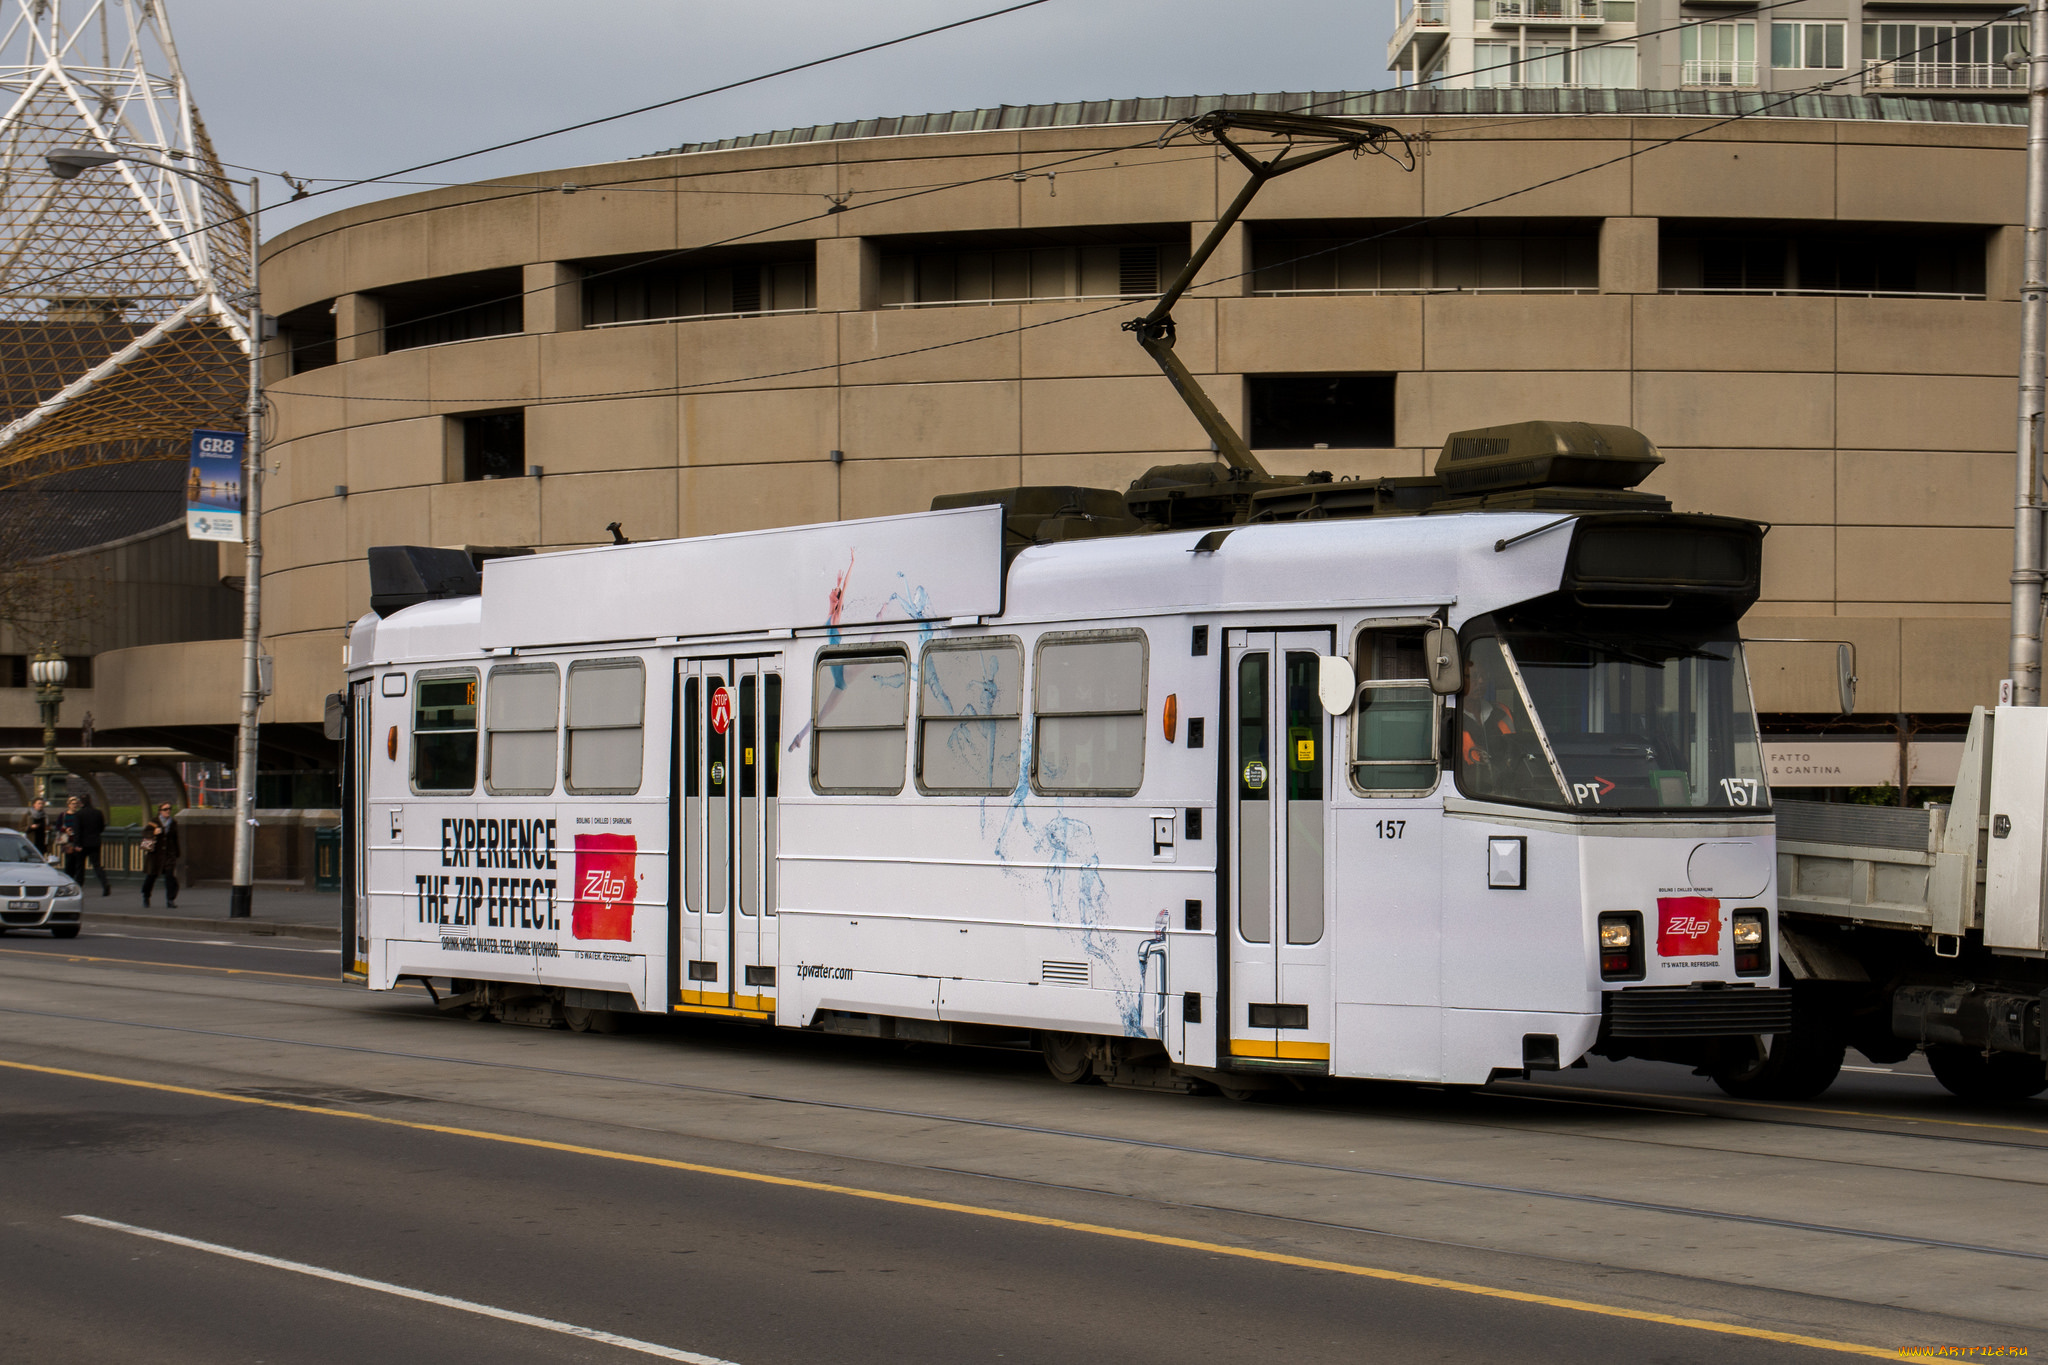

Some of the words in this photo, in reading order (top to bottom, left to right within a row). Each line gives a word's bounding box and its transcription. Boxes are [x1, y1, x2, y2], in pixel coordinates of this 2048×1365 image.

[200, 437, 235, 453] GR8
[714, 694, 728, 706] STOP
[1574, 783, 1600, 804] PT
[1720, 778, 1758, 806] 157
[1376, 820, 1406, 839] 157
[441, 818, 557, 869] EXPERIENCE
[582, 870, 625, 909] Zip
[416, 875, 449, 924] THE
[454, 876, 483, 926] ZIP
[488, 877, 560, 930] EFFECT.
[1666, 917, 1710, 939] Zip
[441, 936, 460, 951] DRINK
[460, 936, 476, 952] MORE
[500, 939, 514, 954] FEEL
[514, 940, 531, 956] MORE
[531, 941, 560, 958] WOOHOO.
